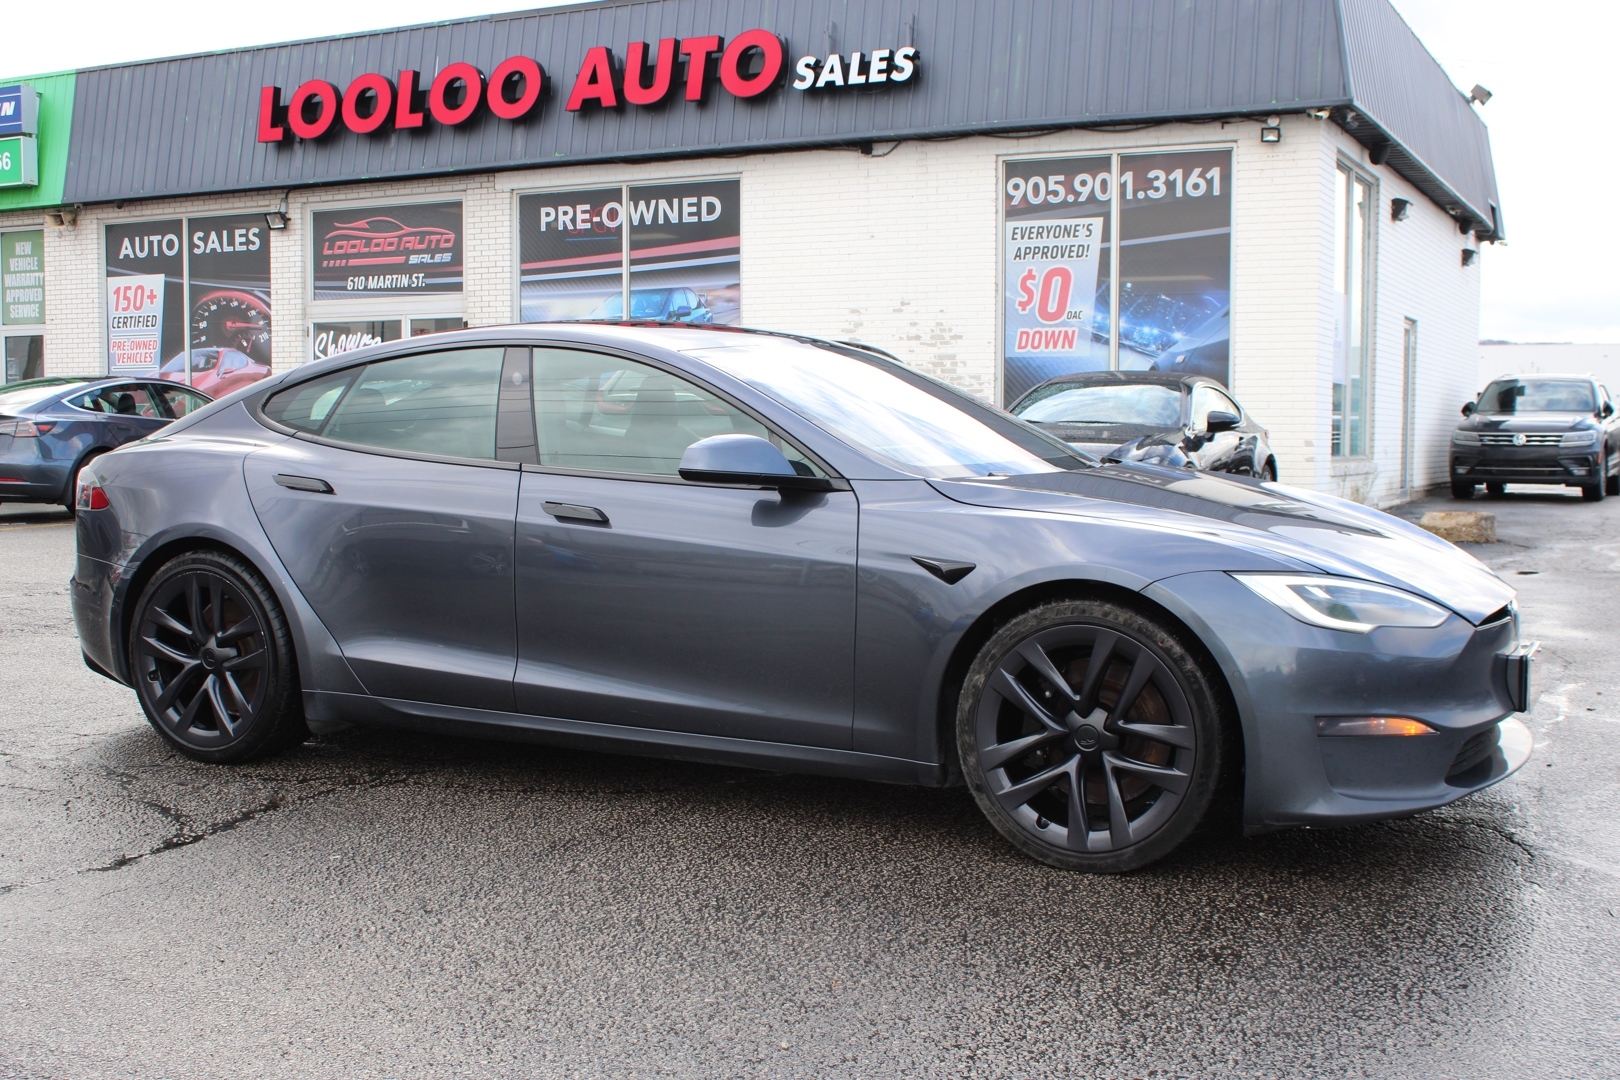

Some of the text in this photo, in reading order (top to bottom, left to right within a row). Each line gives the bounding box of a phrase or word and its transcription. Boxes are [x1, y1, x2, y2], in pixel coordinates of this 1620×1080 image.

[258, 29, 916, 142] LOOLOO AUTO SALES
[0, 101, 15, 116] N
[1006, 166, 1221, 206] 905.901.3161
[540, 196, 722, 232] PRE-OWNED
[1011, 223, 1093, 241] EVERYONE'S
[15, 241, 31, 255] NEW
[119, 228, 260, 259] AUTO SALES
[322, 234, 455, 255] LOOLOO AUTO
[408, 253, 452, 264] SALES
[1013, 244, 1090, 261] APPROVED!
[9, 256, 38, 272] VEHICLE
[4, 272, 44, 288] WARRANTY
[347, 273, 425, 291] 610 MARTIN ST.
[5, 288, 43, 303] APPROVED
[113, 285, 157, 312] 150+
[1017, 266, 1083, 322] $0 OAC
[10, 303, 39, 318] SERVICE
[111, 315, 157, 329] CERTIFIED
[111, 338, 158, 353] PRE-OWNED
[1017, 329, 1076, 350] DOWN
[116, 350, 154, 365] VEHICLES
